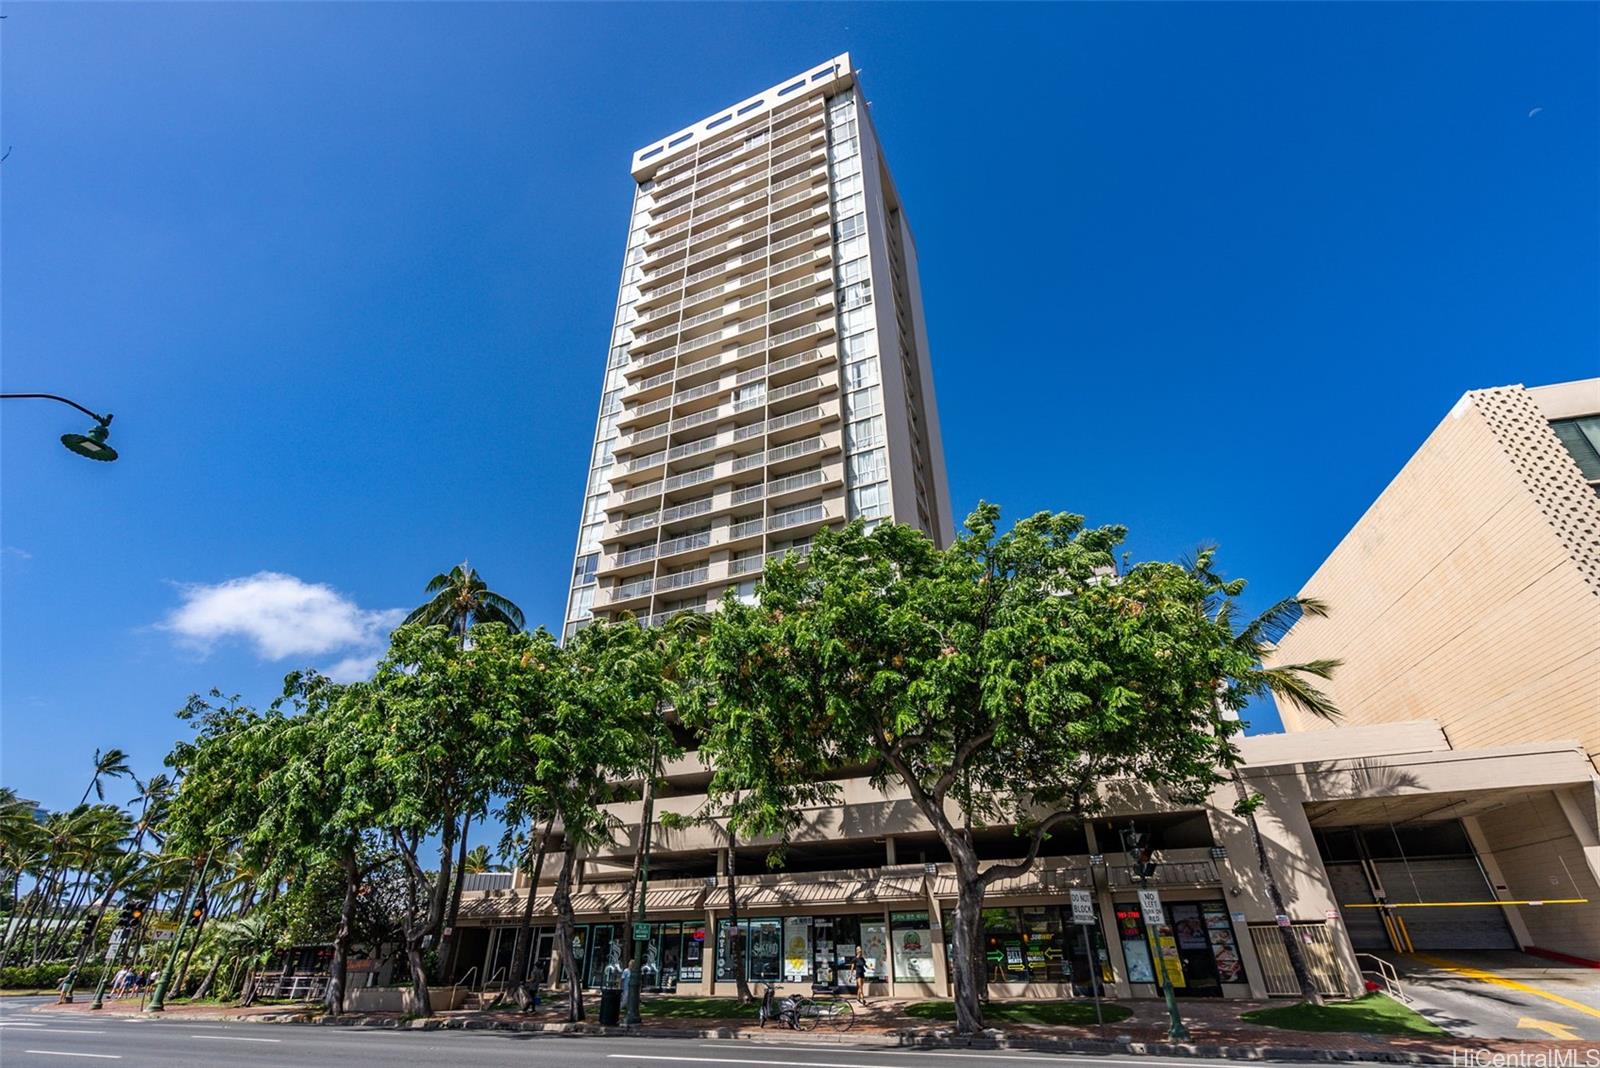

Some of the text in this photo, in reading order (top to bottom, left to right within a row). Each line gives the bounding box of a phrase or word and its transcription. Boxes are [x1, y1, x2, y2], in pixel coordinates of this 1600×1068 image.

[1072, 894, 1089, 902] DO NOT
[1144, 893, 1155, 901] NO
[1144, 900, 1157, 908] LEFT
[1074, 904, 1091, 913] BLOCK
[1031, 933, 1055, 941] SUBWAY
[718, 920, 726, 977] TATTOO
